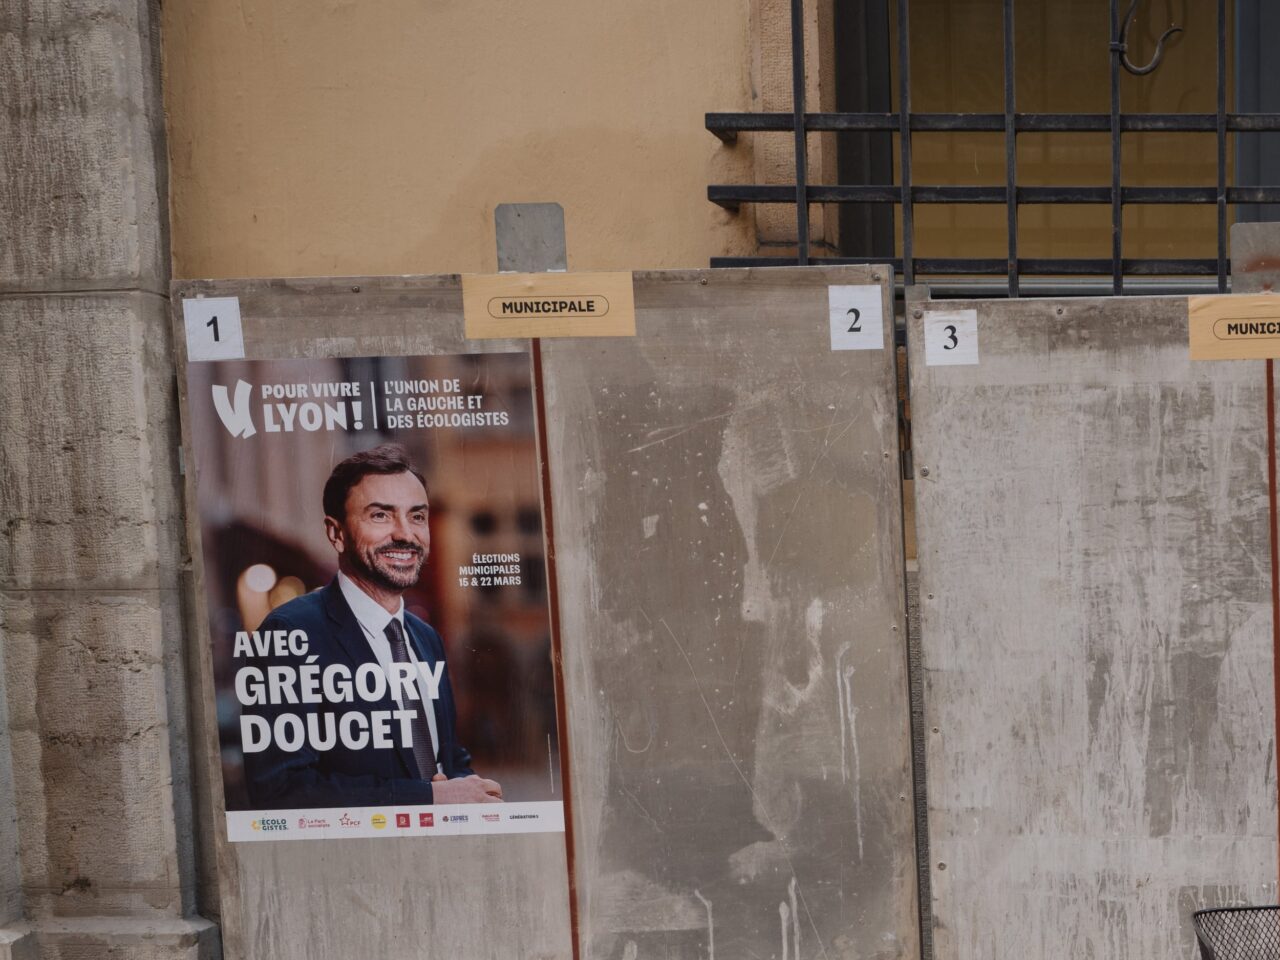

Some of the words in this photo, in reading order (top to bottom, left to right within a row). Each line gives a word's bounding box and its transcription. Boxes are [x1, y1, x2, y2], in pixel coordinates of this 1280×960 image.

[502, 301, 595, 313] MUNICIPALE
[207, 316, 219, 341] 1
[847, 308, 861, 332] 2
[944, 325, 958, 349] 3
[262, 382, 310, 398] POUR
[311, 380, 360, 398] VIVRE
[385, 380, 439, 394] L'UNION
[443, 379, 460, 392] DE
[386, 398, 403, 411] LA
[407, 396, 464, 411] GAUCHE
[468, 396, 482, 409] ET
[388, 415, 413, 428] DES
[417, 409, 508, 427] ÉCOLOGISTES
[473, 553, 520, 563] ÉLECTIONS
[459, 565, 520, 577] MUNICIPALES
[459, 578, 468, 586] 15
[471, 577, 478, 586] &
[481, 577, 491, 586] 22
[494, 576, 521, 585] MARS
[234, 630, 310, 659] AVEC
[234, 655, 445, 707] GRÉGORY
[240, 708, 417, 752] DOUCET
